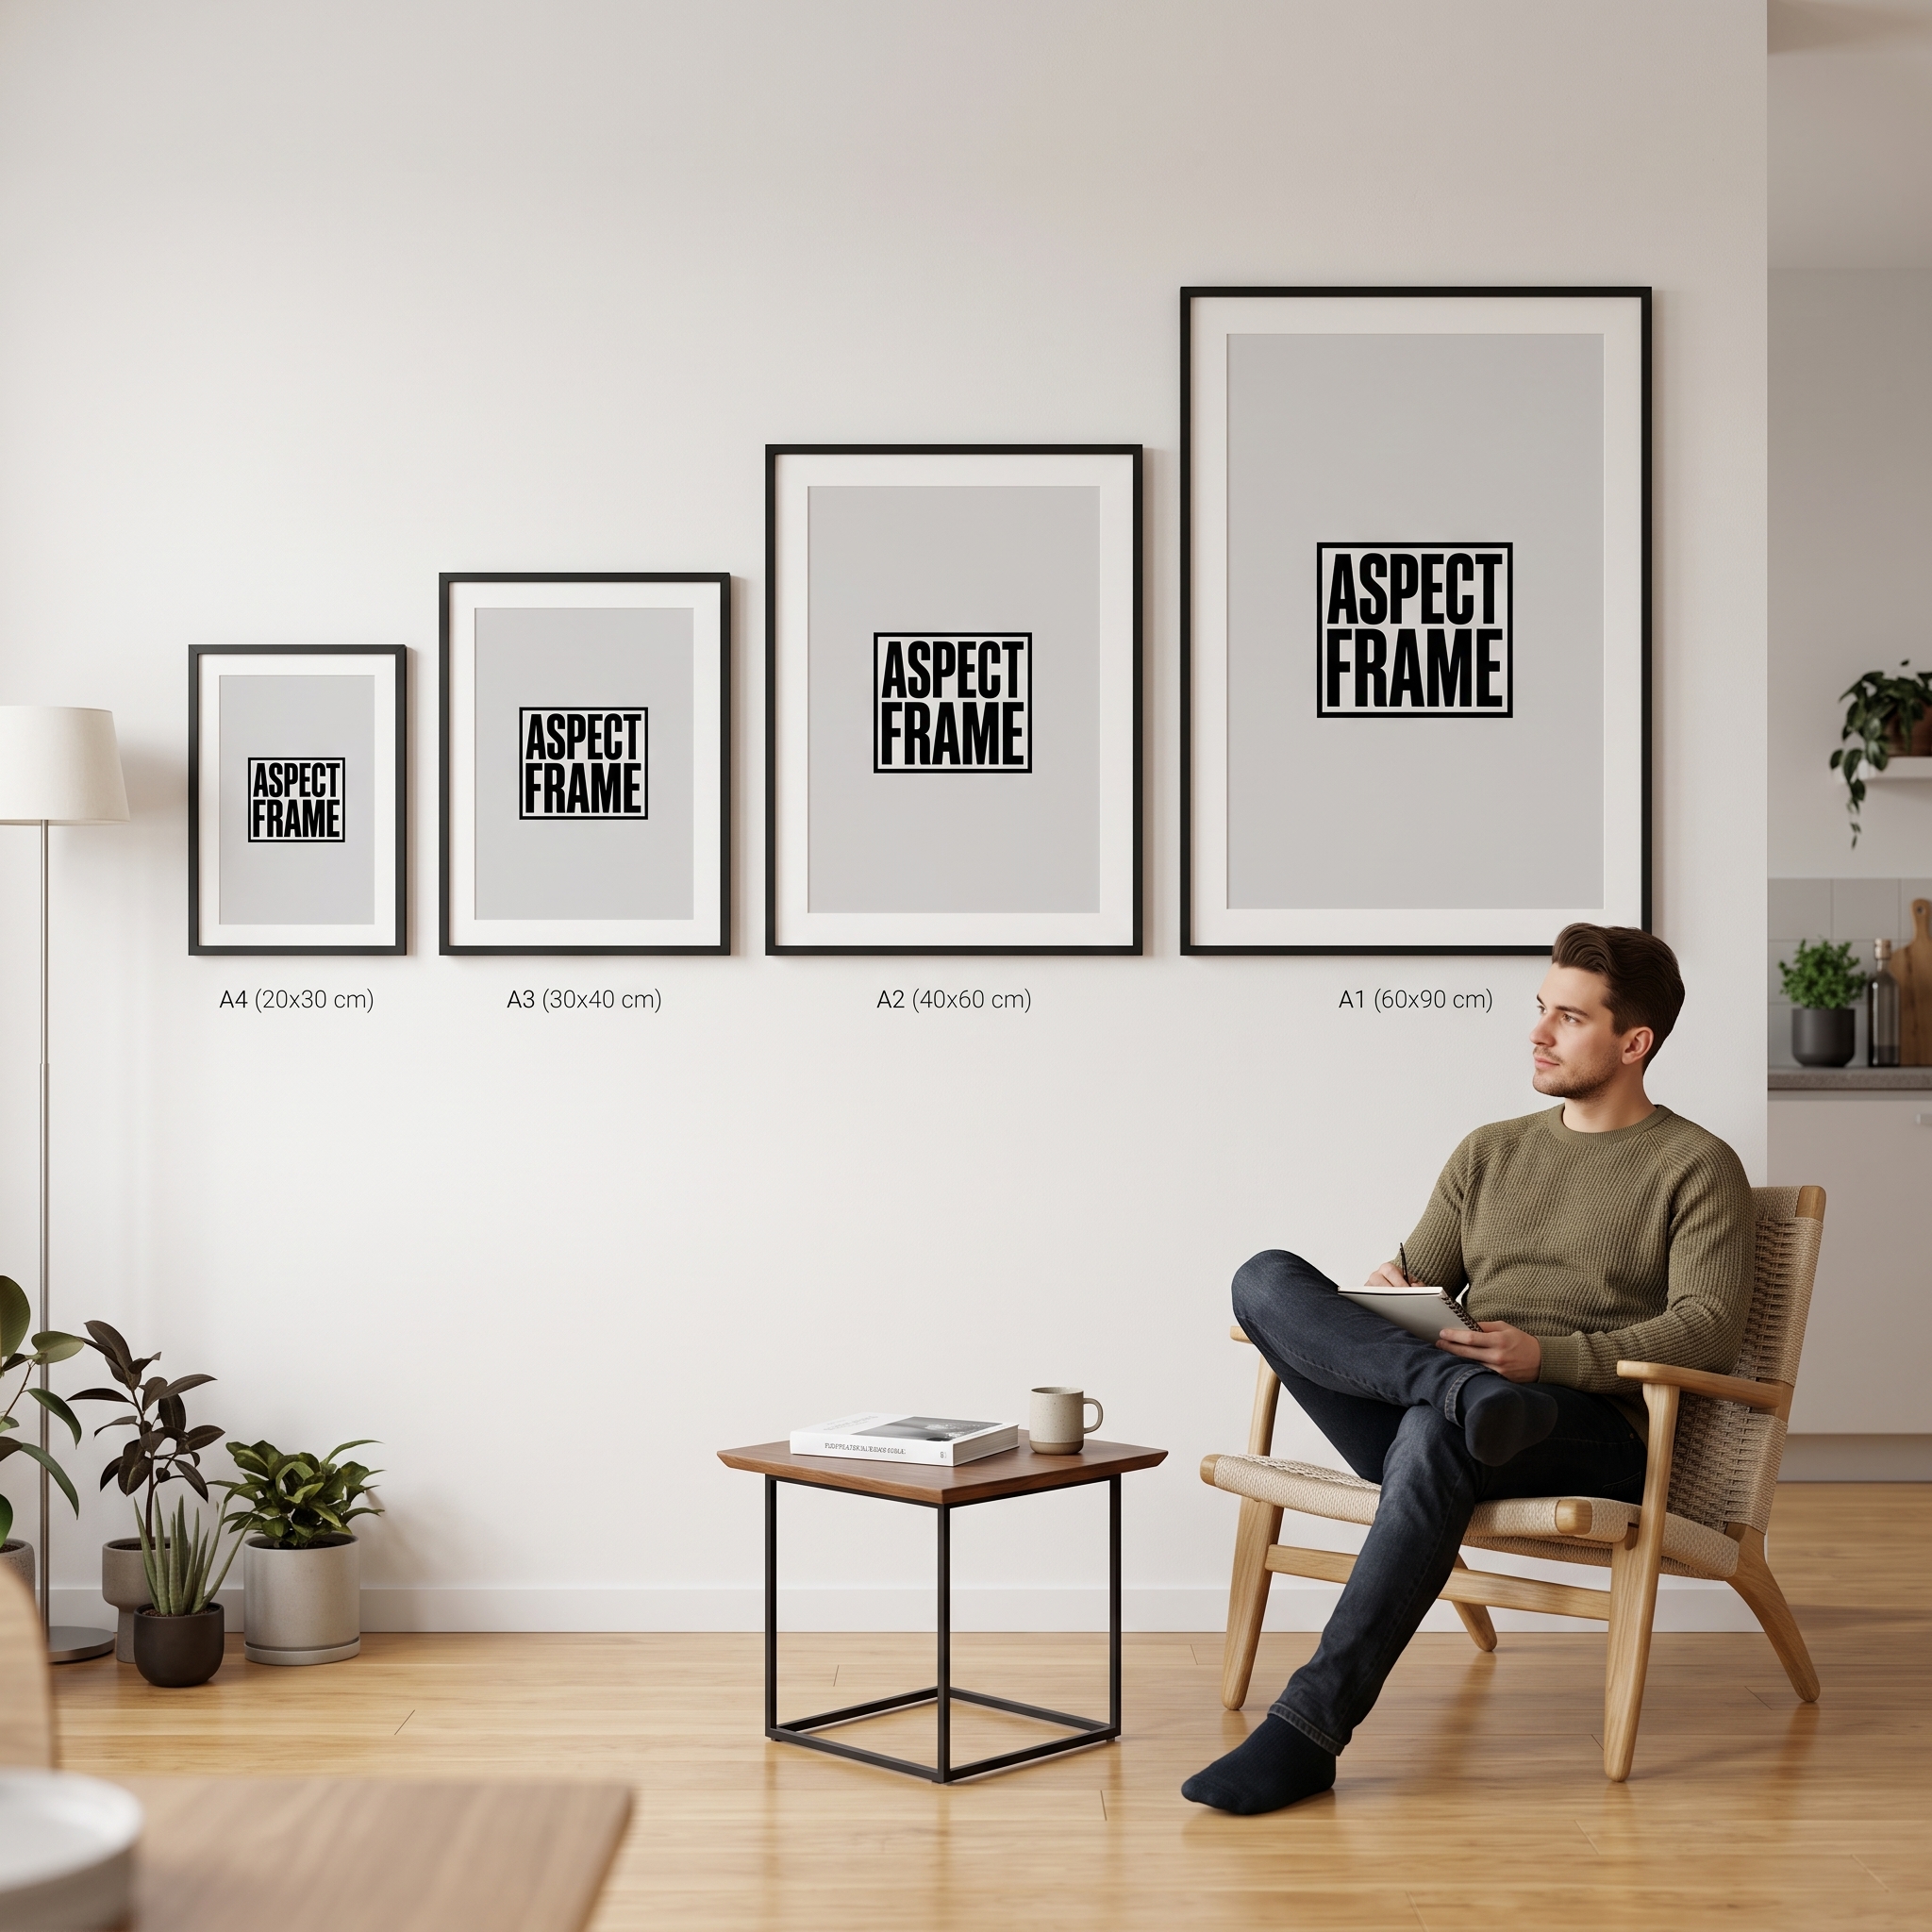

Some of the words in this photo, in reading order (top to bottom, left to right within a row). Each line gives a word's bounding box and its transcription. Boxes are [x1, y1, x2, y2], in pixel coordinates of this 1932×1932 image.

[1326, 553, 1503, 625] ASPECT
[881, 641, 1024, 699] ASPECT
[1326, 628, 1503, 708] FRAME
[525, 713, 641, 760] ASPECT
[881, 701, 1024, 765] FRAME
[252, 762, 341, 798] ASPECT
[525, 763, 641, 813] FRAME
[252, 799, 341, 838] FRAME
